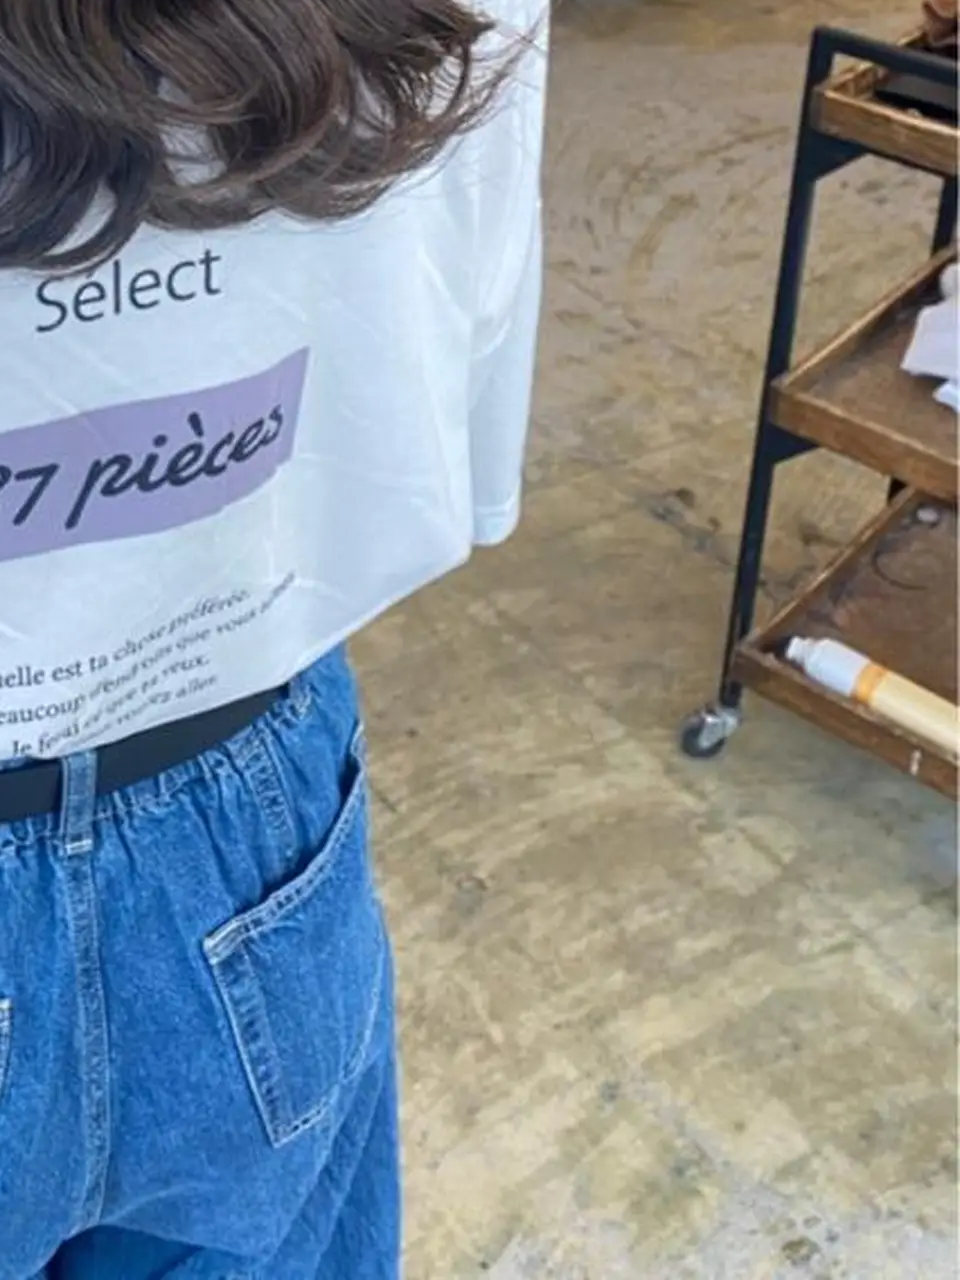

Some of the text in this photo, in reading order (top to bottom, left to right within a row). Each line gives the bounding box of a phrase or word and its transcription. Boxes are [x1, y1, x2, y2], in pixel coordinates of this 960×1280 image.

[65, 403, 284, 530] pièces
[51, 660, 83, 682] est
[88, 655, 108, 674] ta
